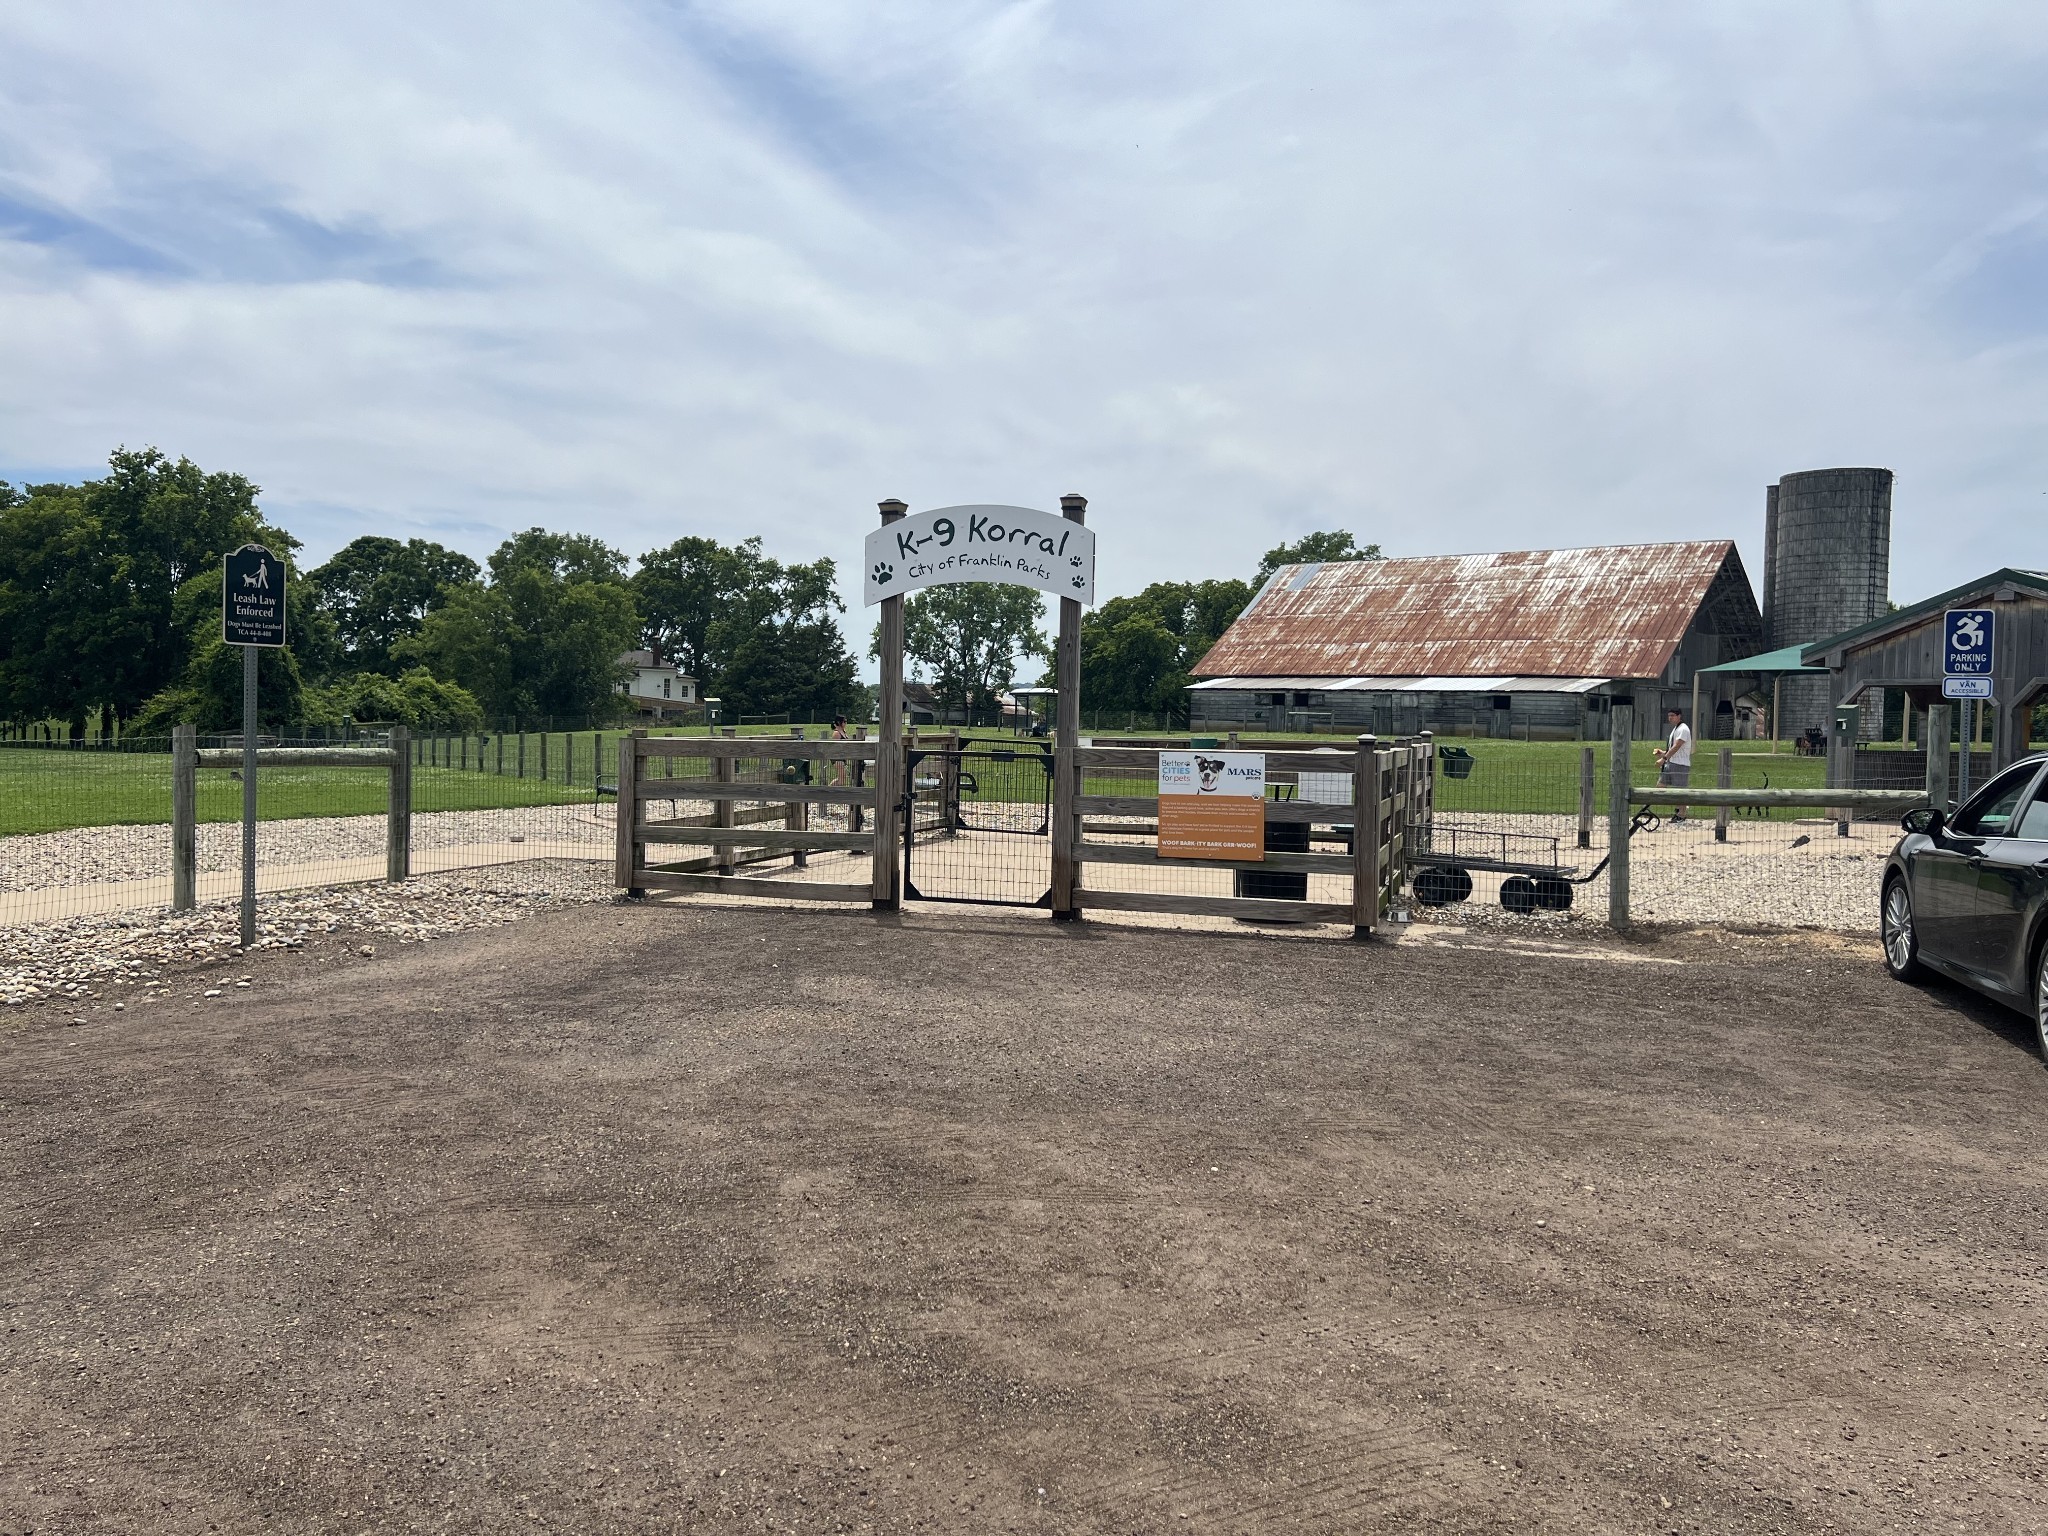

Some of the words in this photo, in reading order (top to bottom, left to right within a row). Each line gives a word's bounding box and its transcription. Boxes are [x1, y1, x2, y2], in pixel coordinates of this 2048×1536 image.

[897, 518, 955, 560] K-9
[968, 513, 1070, 557] Korral
[908, 562, 934, 578] City
[938, 555, 956, 570] of
[958, 553, 1012, 569] Franklin
[1016, 558, 1051, 580] Parks
[233, 592, 257, 604] Leash
[259, 594, 277, 605] Law
[236, 605, 274, 618] Enforced
[1950, 653, 1987, 662] PARKING
[1954, 663, 1982, 672] ONLY
[1161, 759, 1184, 767] Better
[1162, 767, 1190, 775] CITIES
[1227, 768, 1262, 776] MARS
[1162, 774, 1173, 782] for
[1173, 775, 1191, 783] pets
